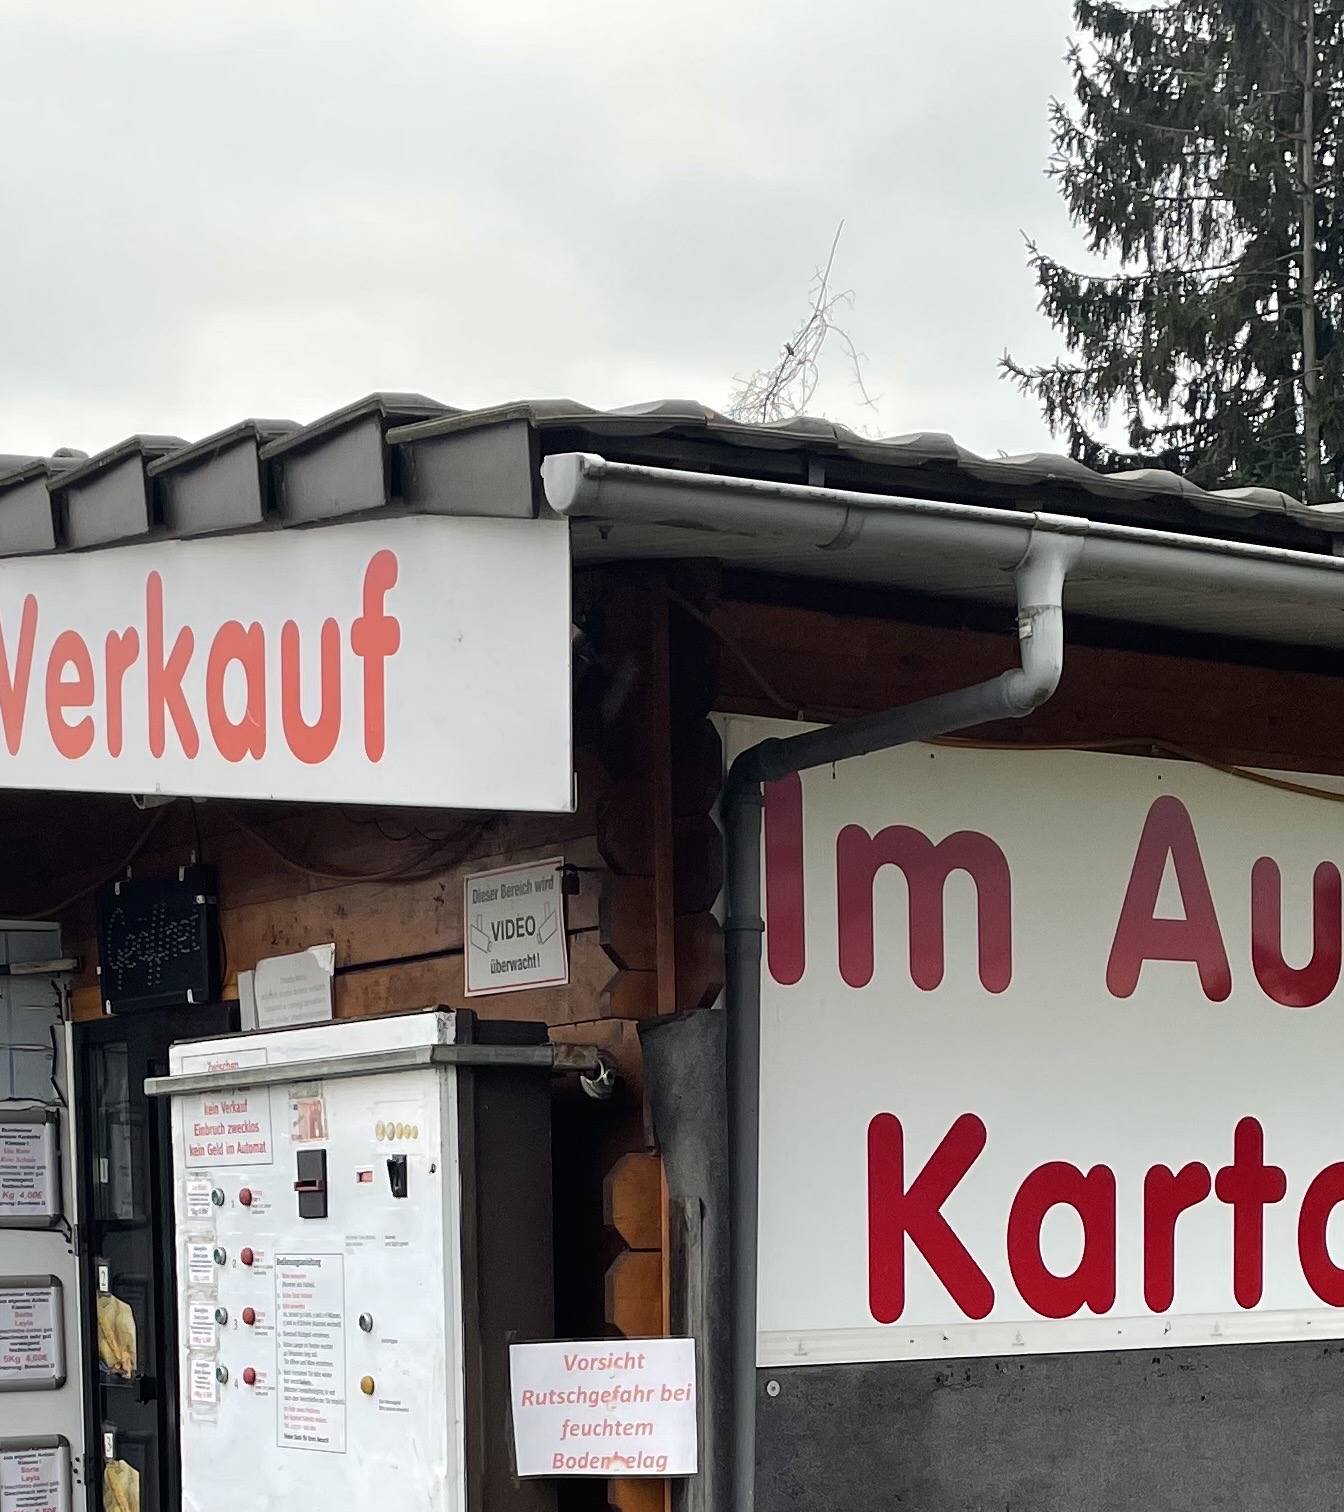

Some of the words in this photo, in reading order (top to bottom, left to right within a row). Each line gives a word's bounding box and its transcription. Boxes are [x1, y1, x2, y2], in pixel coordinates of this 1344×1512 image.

[473, 888, 498, 904] Dieser
[501, 880, 532, 899] Bereich
[535, 874, 553, 892] wird
[765, 771, 1012, 993] Im
[491, 916, 535, 941] VIDEO
[490, 953, 540, 974] überwacht!
[204, 1102, 219, 1115] kein
[221, 1099, 247, 1113] Verkauf
[194, 1123, 225, 1136] Einbruch
[227, 1120, 259, 1134] zwecklos
[190, 1143, 205, 1156] kein
[207, 1142, 223, 1155] Geld
[226, 1141, 235, 1154] im
[237, 1141, 266, 1154] Automat
[2, 1191, 14, 1200] Kg
[563, 1352, 645, 1371] Vorsicht
[522, 1385, 654, 1407] Rutschgefahr
[660, 1383, 692, 1401] bei
[560, 1419, 653, 1440] feuchtem
